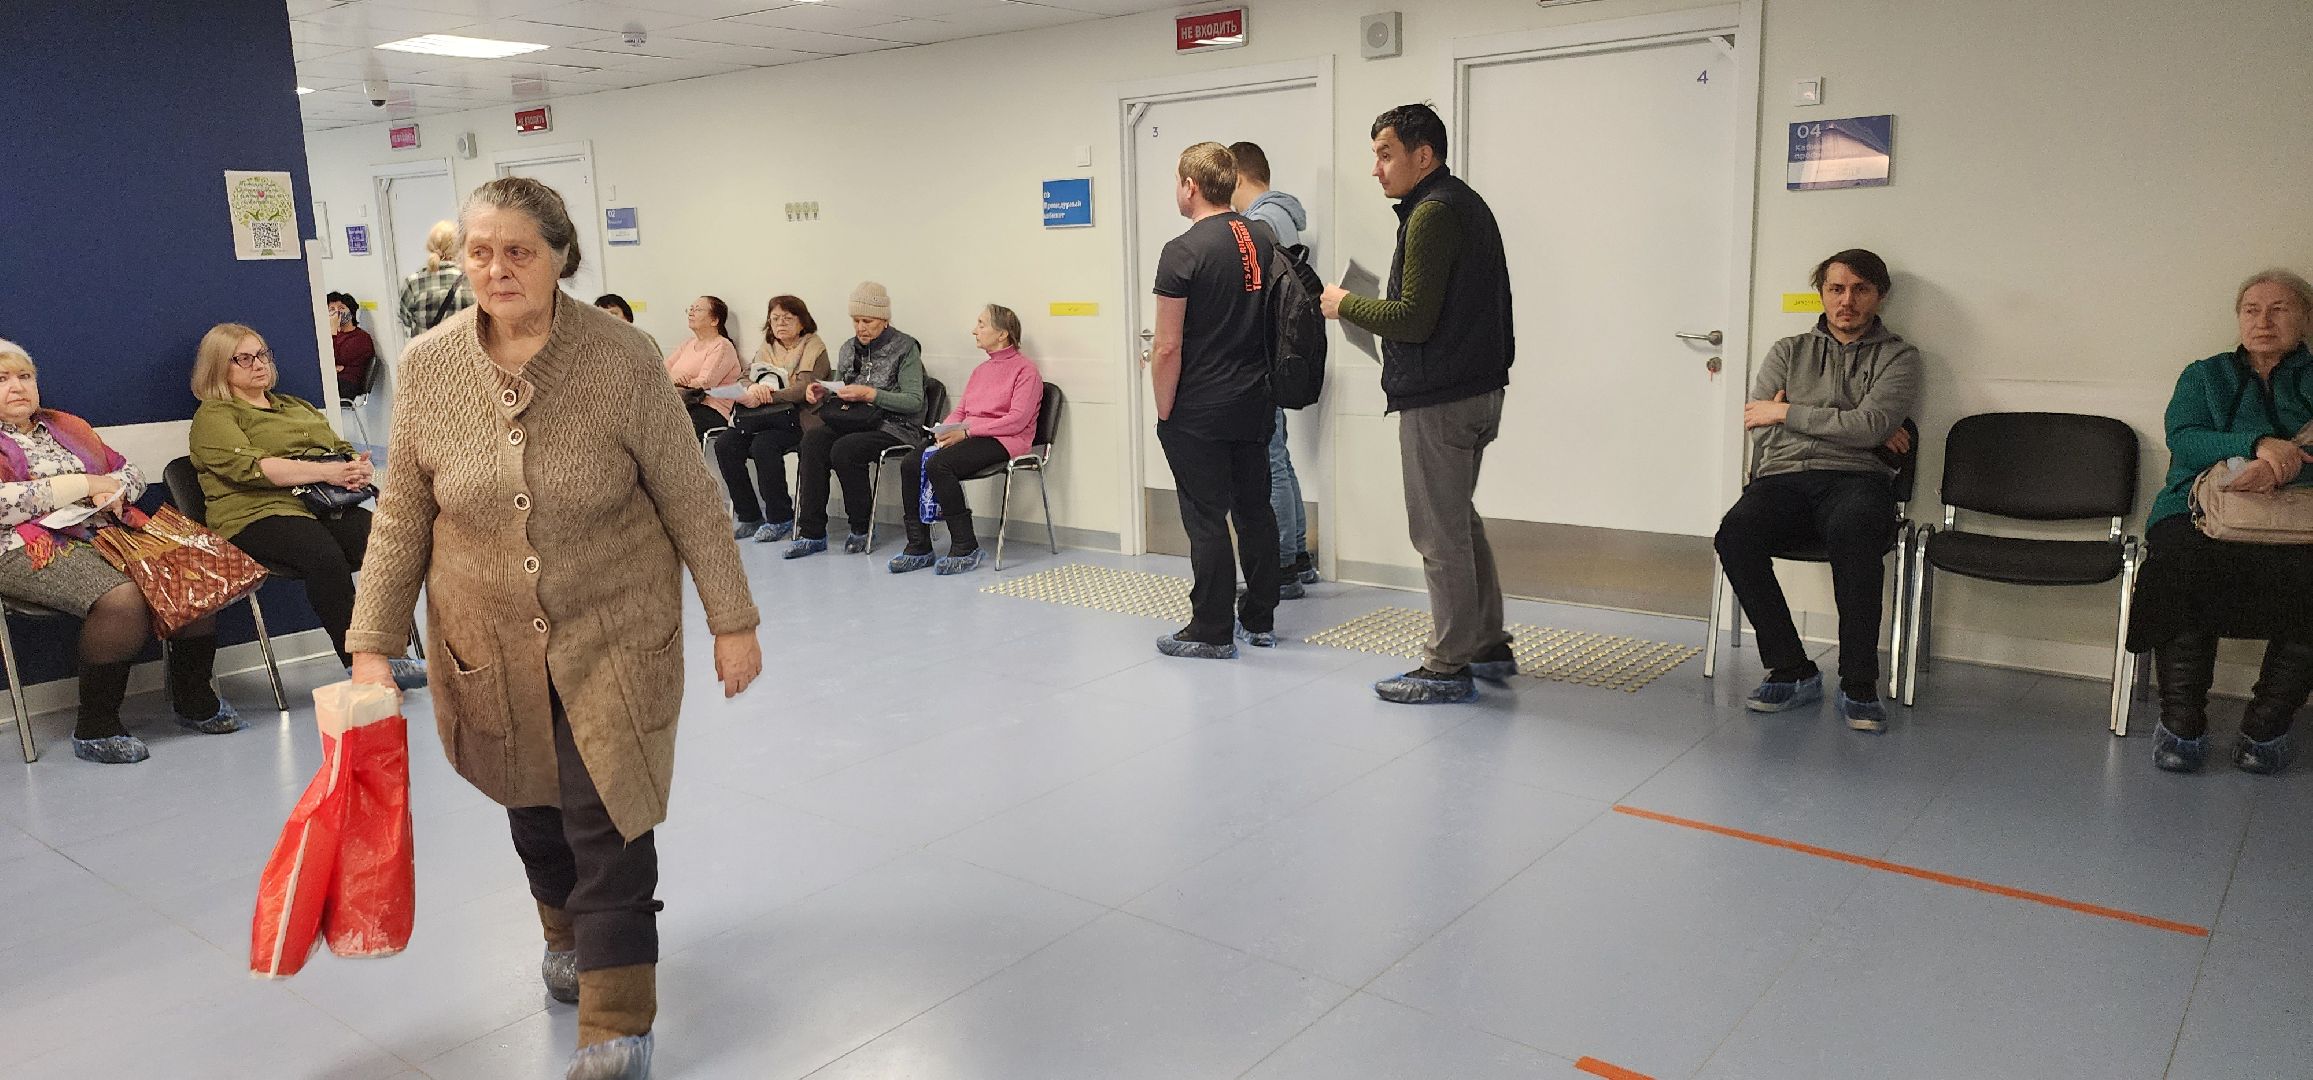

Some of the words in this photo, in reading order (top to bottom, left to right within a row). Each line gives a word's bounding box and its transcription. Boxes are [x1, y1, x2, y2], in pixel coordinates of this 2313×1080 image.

[1181, 26, 1193, 39] НЕ
[1195, 20, 1237, 37] ВХОДИТЬ
[1696, 70, 1708, 84] 4
[1153, 126, 1159, 137] 3
[1797, 123, 1821, 138] 04
